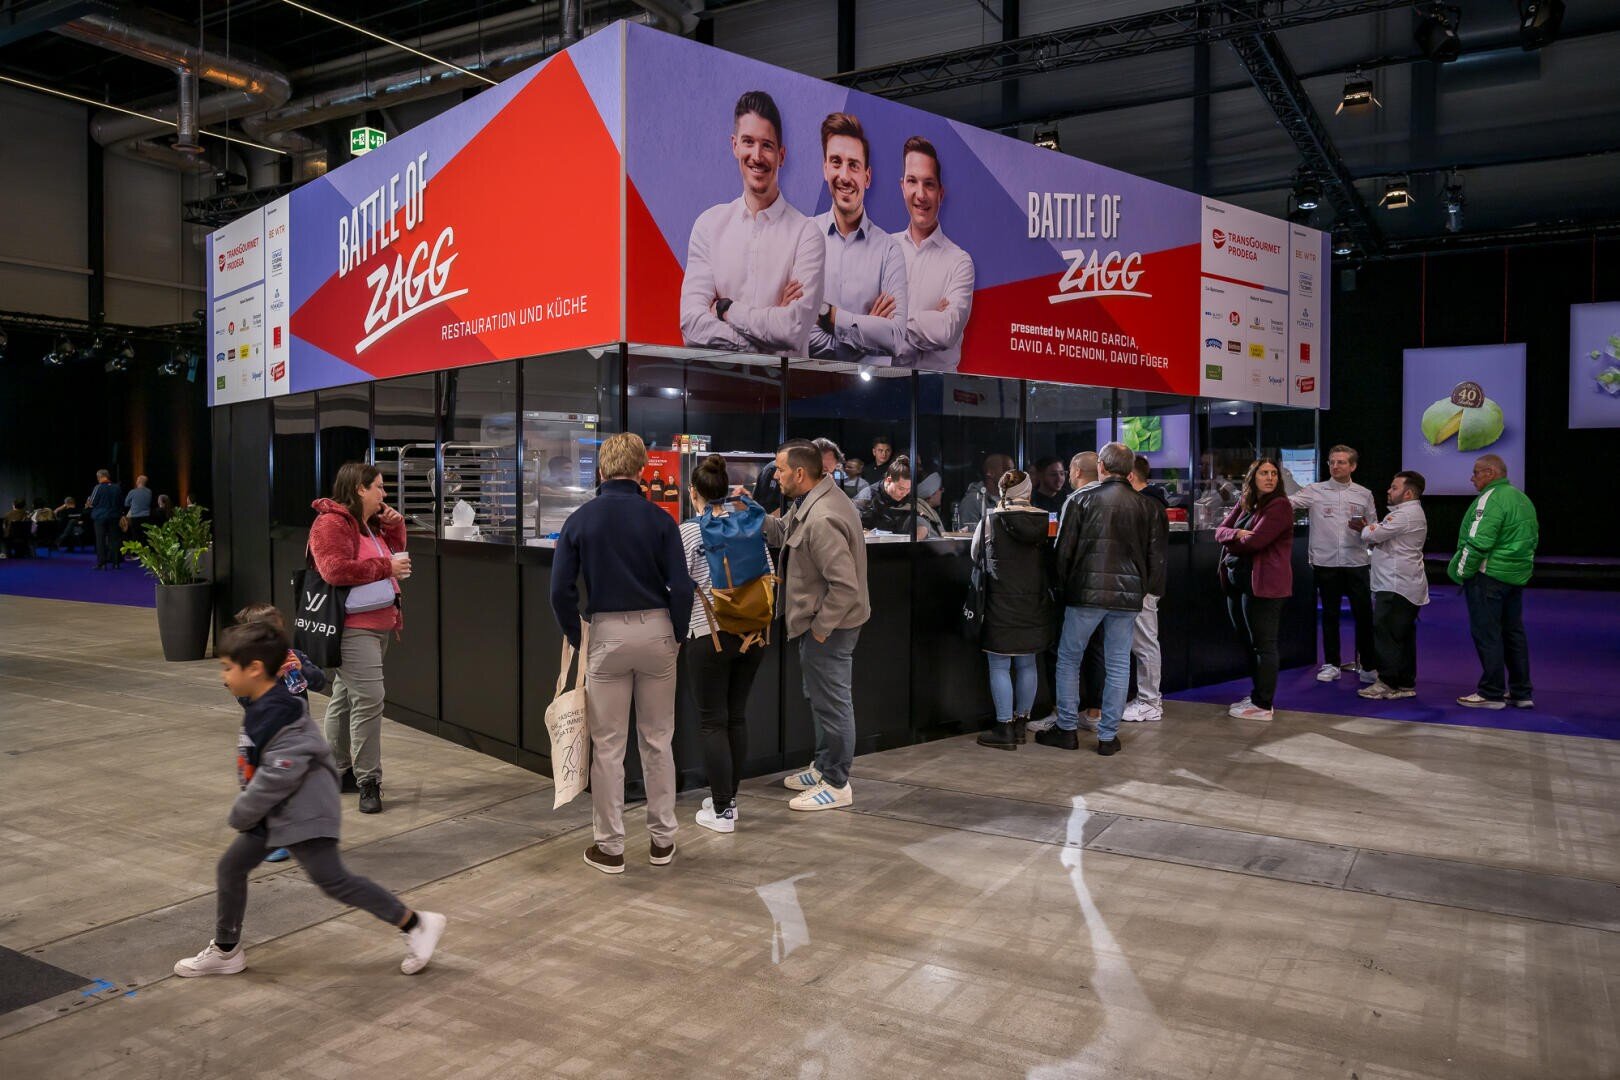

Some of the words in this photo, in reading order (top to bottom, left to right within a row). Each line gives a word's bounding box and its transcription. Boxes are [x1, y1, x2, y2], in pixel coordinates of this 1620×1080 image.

[339, 172, 401, 278] BATTLE
[405, 151, 428, 231] OF
[1028, 191, 1095, 239] BATTLE
[1101, 194, 1121, 239] OF
[1058, 248, 1145, 293] ZAGG
[1228, 245, 1258, 261] PRODEGA
[363, 226, 460, 335] ZAGG
[441, 311, 516, 341] RESTAURATION
[519, 305, 543, 326] UND
[546, 294, 588, 320] KÜCHE
[1010, 337, 1042, 354] DAVID
[1045, 342, 1056, 356] A.
[1059, 343, 1108, 363] PICENONI,
[1110, 350, 1138, 365] DAVID
[1140, 352, 1169, 369] FÜGER
[1011, 323, 1053, 337] presented
[1055, 327, 1065, 340] by
[1066, 327, 1098, 343] MARIO
[1101, 332, 1139, 351] GARCIA,
[1459, 389, 1476, 401] 40
[311, 621, 336, 637] yap
